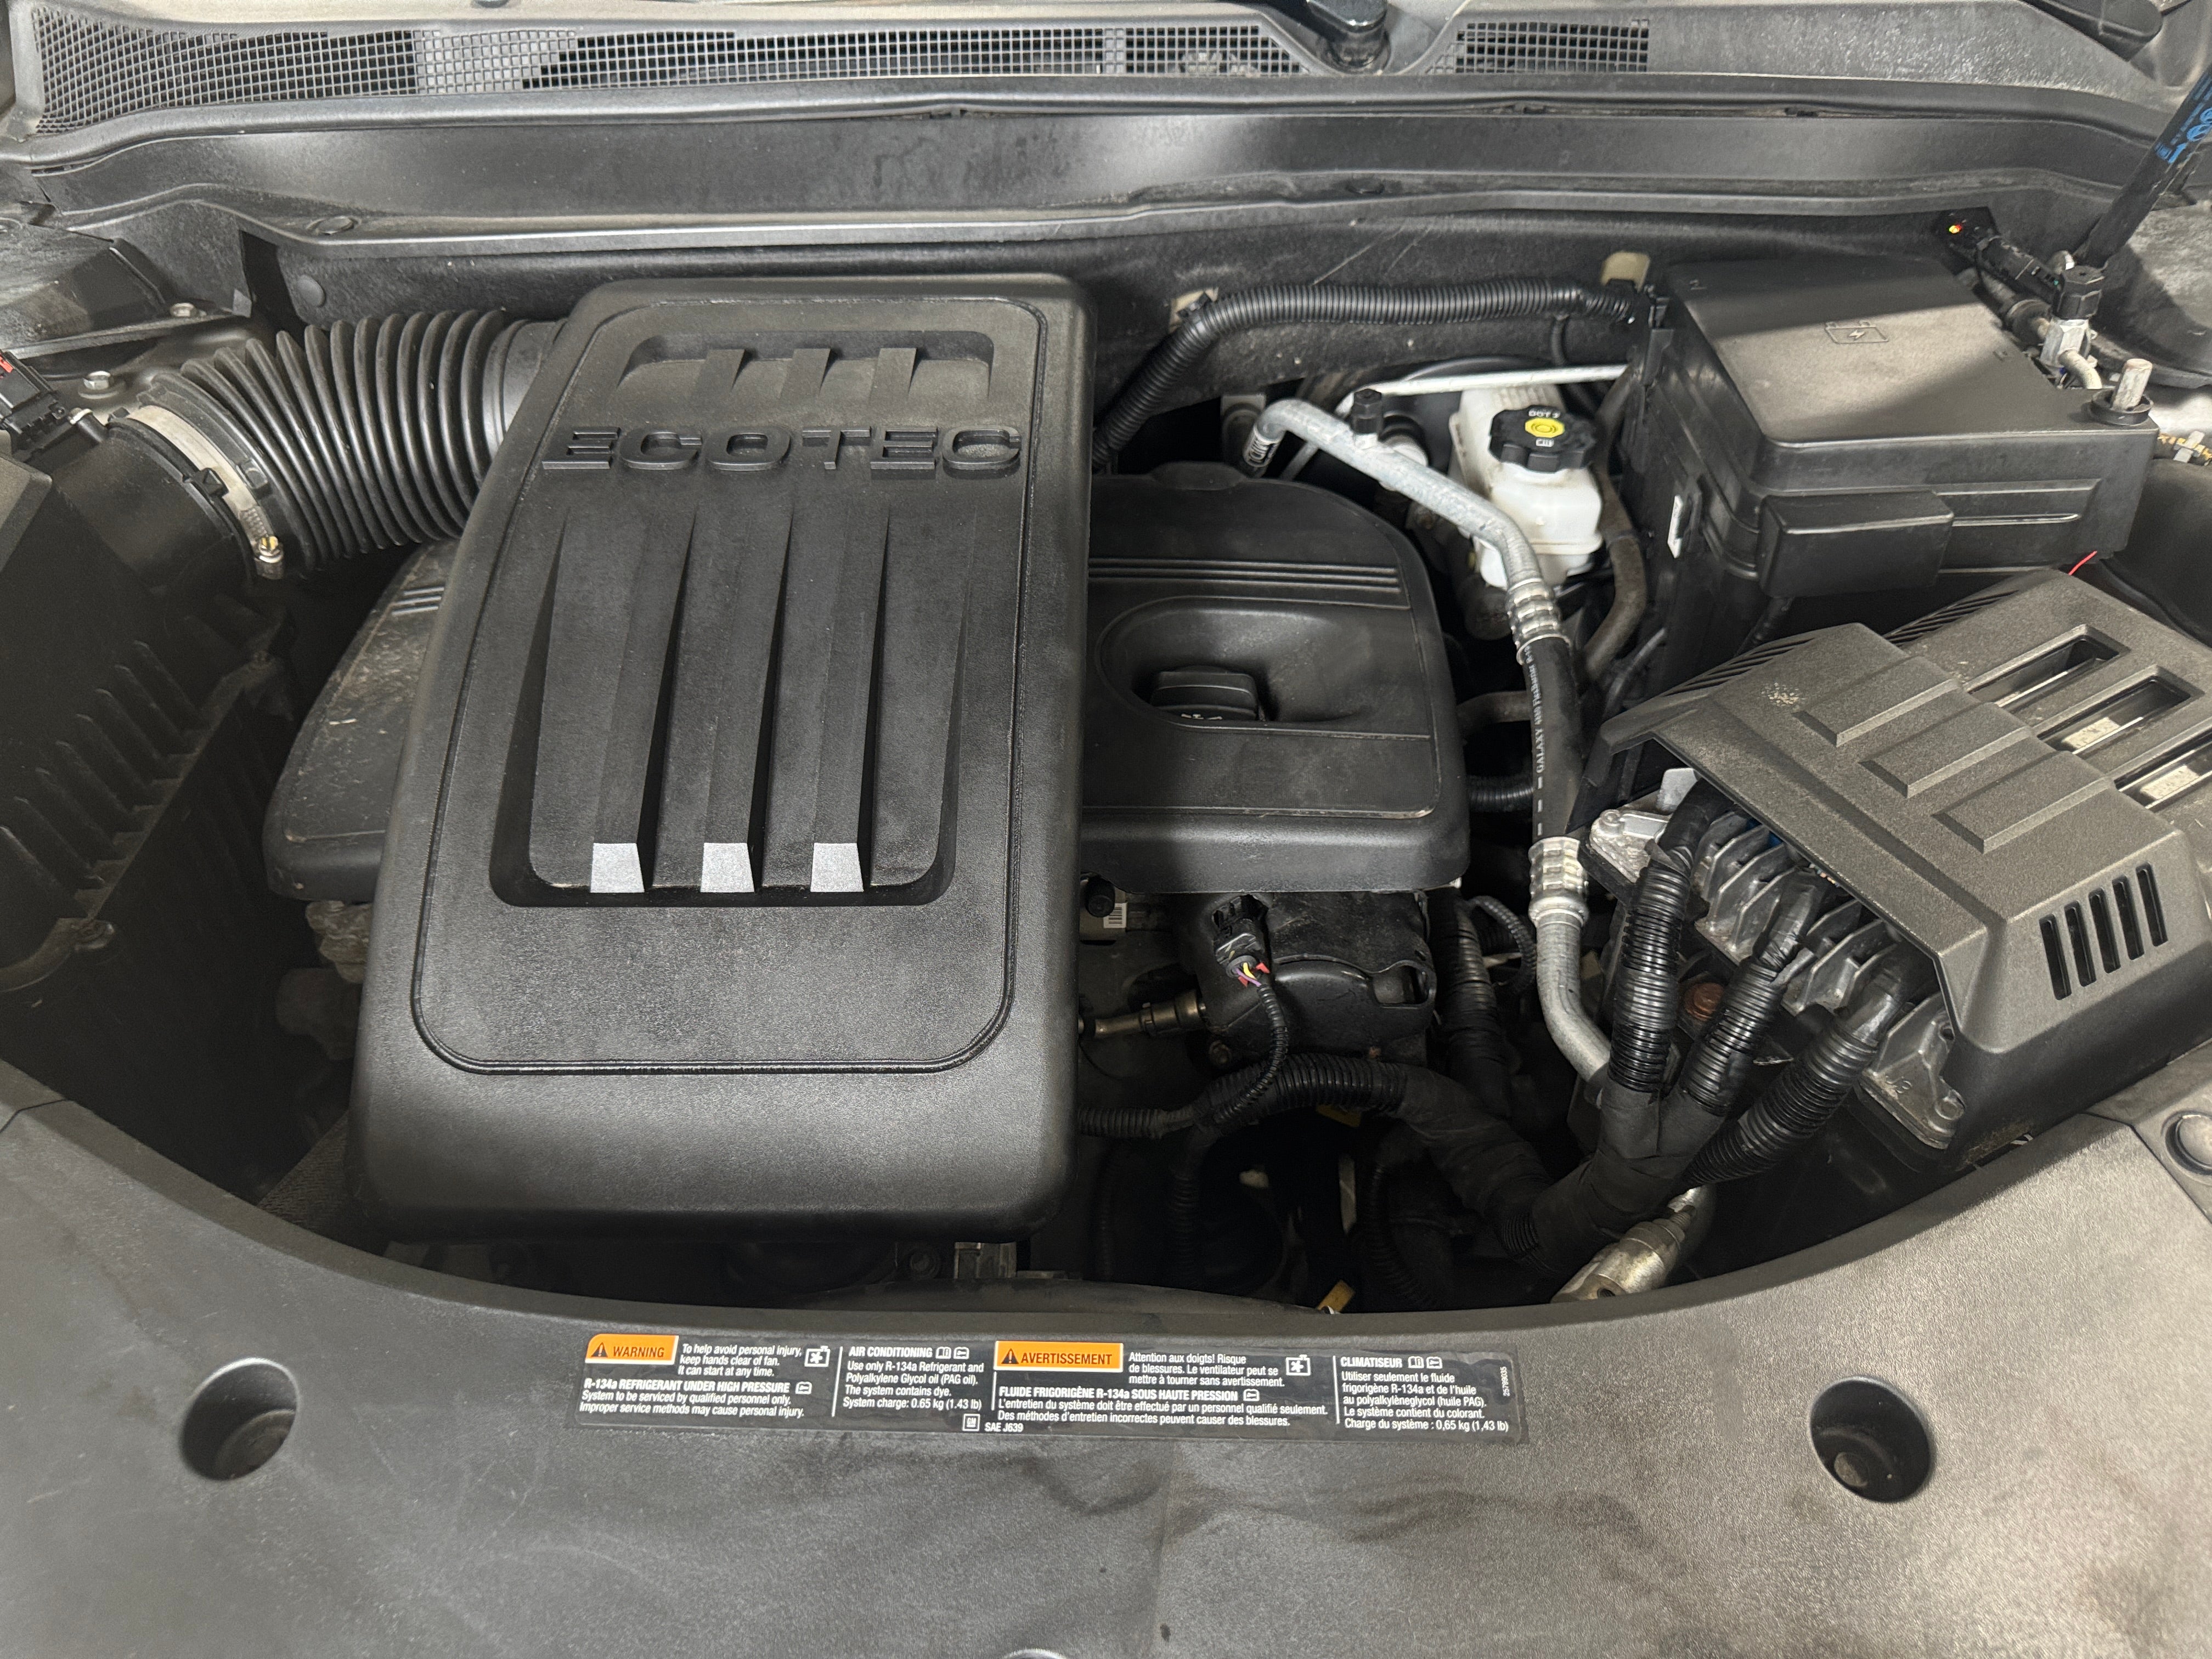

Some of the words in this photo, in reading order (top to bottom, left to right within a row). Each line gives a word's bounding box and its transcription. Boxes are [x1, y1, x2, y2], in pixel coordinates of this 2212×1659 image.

[542, 426, 1022, 473] ECOTEC
[1535, 728, 1545, 774] GALAXY
[613, 1346, 665, 1358] WARNING
[682, 1343, 693, 1354] To
[695, 1344, 712, 1356] help
[714, 1345, 737, 1355] avoid
[739, 1345, 775, 1358] personal
[849, 1346, 866, 1357] AIR
[867, 1346, 933, 1358] CONDITIONING
[680, 1354, 701, 1365] keep
[702, 1355, 729, 1365] hands
[730, 1356, 752, 1365] clear
[754, 1356, 763, 1366] of
[764, 1356, 780, 1367] fan.
[1021, 1353, 1112, 1365] AVERTISSEMENT
[1128, 1352, 1166, 1363] Attention
[1169, 1355, 1184, 1363] aux
[1186, 1353, 1215, 1365] doigts!
[1217, 1355, 1246, 1365] Risque
[1340, 1356, 1402, 1368] CLIMATISEUR
[678, 1365, 684, 1375] It
[686, 1368, 702, 1376] can
[704, 1366, 724, 1376] start
[725, 1368, 734, 1377] at
[736, 1368, 751, 1379] any
[753, 1367, 775, 1378] time.
[848, 1361, 864, 1371] Use
[865, 1361, 883, 1374] only
[885, 1361, 917, 1372] R-134a
[919, 1362, 967, 1374] Refrigerant
[968, 1363, 984, 1373] and
[1128, 1364, 1140, 1373] de
[1142, 1364, 1185, 1374] blessures.
[1187, 1365, 1198, 1374] Le
[1200, 1365, 1244, 1375] ventilateur
[1246, 1366, 1266, 1376] peut
[845, 1373, 899, 1385] Polyalkylene
[901, 1374, 927, 1385] Glycol
[928, 1374, 939, 1383] oil
[940, 1374, 961, 1385] (PAG
[962, 1375, 978, 1385] oil).
[1128, 1375, 1157, 1384] mettre
[1159, 1375, 1165, 1384] à
[1166, 1376, 1197, 1385] tourner
[1222, 1377, 1285, 1387] avertissement.
[1342, 1371, 1371, 1381] Utiliser
[1373, 1372, 1419, 1382] seulement
[1420, 1372, 1429, 1382] le
[1430, 1372, 1455, 1383] fluide
[584, 1379, 617, 1390] R-134a
[619, 1379, 682, 1391] REFRIGERANT
[685, 1381, 715, 1391] UNDER
[718, 1382, 739, 1392] HIGH
[741, 1383, 791, 1393] PRESSURE
[845, 1385, 861, 1395] The
[862, 1386, 894, 1397] system
[895, 1386, 932, 1396] contains
[934, 1386, 952, 1397] dye.
[1342, 1384, 1390, 1396] frigorigène
[1391, 1385, 1424, 1395] R-134a
[1426, 1385, 1435, 1395] et
[1437, 1385, 1448, 1395] de
[582, 1390, 613, 1402] System
[616, 1391, 624, 1401] to
[626, 1391, 637, 1402] be
[639, 1392, 675, 1403] serviced
[677, 1392, 687, 1406] by
[689, 1392, 725, 1406] qualified
[727, 1394, 770, 1407] personnel
[772, 1395, 791, 1406] only.
[999, 1386, 1031, 1397] FLUIDE
[1096, 1388, 1129, 1399] R-134a
[1131, 1389, 1157, 1400] SOUS
[1159, 1390, 1189, 1400] HAUTE
[1191, 1390, 1238, 1401] PRESSION
[843, 1397, 876, 1409] System
[877, 1398, 910, 1410] charge:
[911, 1398, 931, 1409] 0.65
[933, 1398, 945, 1410] kg
[946, 1399, 969, 1410] (1.43
[970, 1399, 982, 1410] lb)
[1046, 1399, 1057, 1409] du
[1096, 1400, 1114, 1410] doit
[1115, 1401, 1132, 1411] être
[1135, 1401, 1169, 1412] effectué
[1172, 1404, 1187, 1413] par
[1201, 1403, 1244, 1414] personnel
[1246, 1403, 1278, 1415] qualifié
[1280, 1404, 1328, 1415] seulement.
[1437, 1397, 1462, 1408] (huile
[1464, 1397, 1487, 1409] PAG).
[580, 1402, 618, 1415] Improper
[620, 1403, 651, 1413] service
[653, 1403, 690, 1414] methods
[692, 1406, 710, 1418] may
[712, 1406, 737, 1416] cause
[740, 1406, 777, 1419] personal
[778, 1407, 804, 1419] injury.
[1344, 1407, 1355, 1417] Le
[1356, 1407, 1395, 1419] système
[1396, 1408, 1432, 1418] contient
[1434, 1408, 1445, 1418] du
[1447, 1408, 1485, 1419] colorant.
[998, 1410, 1015, 1420] Des
[1110, 1413, 1158, 1423] incorrectes
[1160, 1415, 1195, 1425] peuvent
[1228, 1415, 1244, 1425] des
[1246, 1415, 1290, 1426] blessures.
[984, 1422, 1002, 1432] SAE
[1002, 1423, 1024, 1432] J639
[1345, 1419, 1376, 1431] Charge
[1378, 1419, 1390, 1429] du
[1392, 1419, 1429, 1431] système
[1458, 1420, 1470, 1432] kg
[1497, 1421, 1509, 1432] lb)
